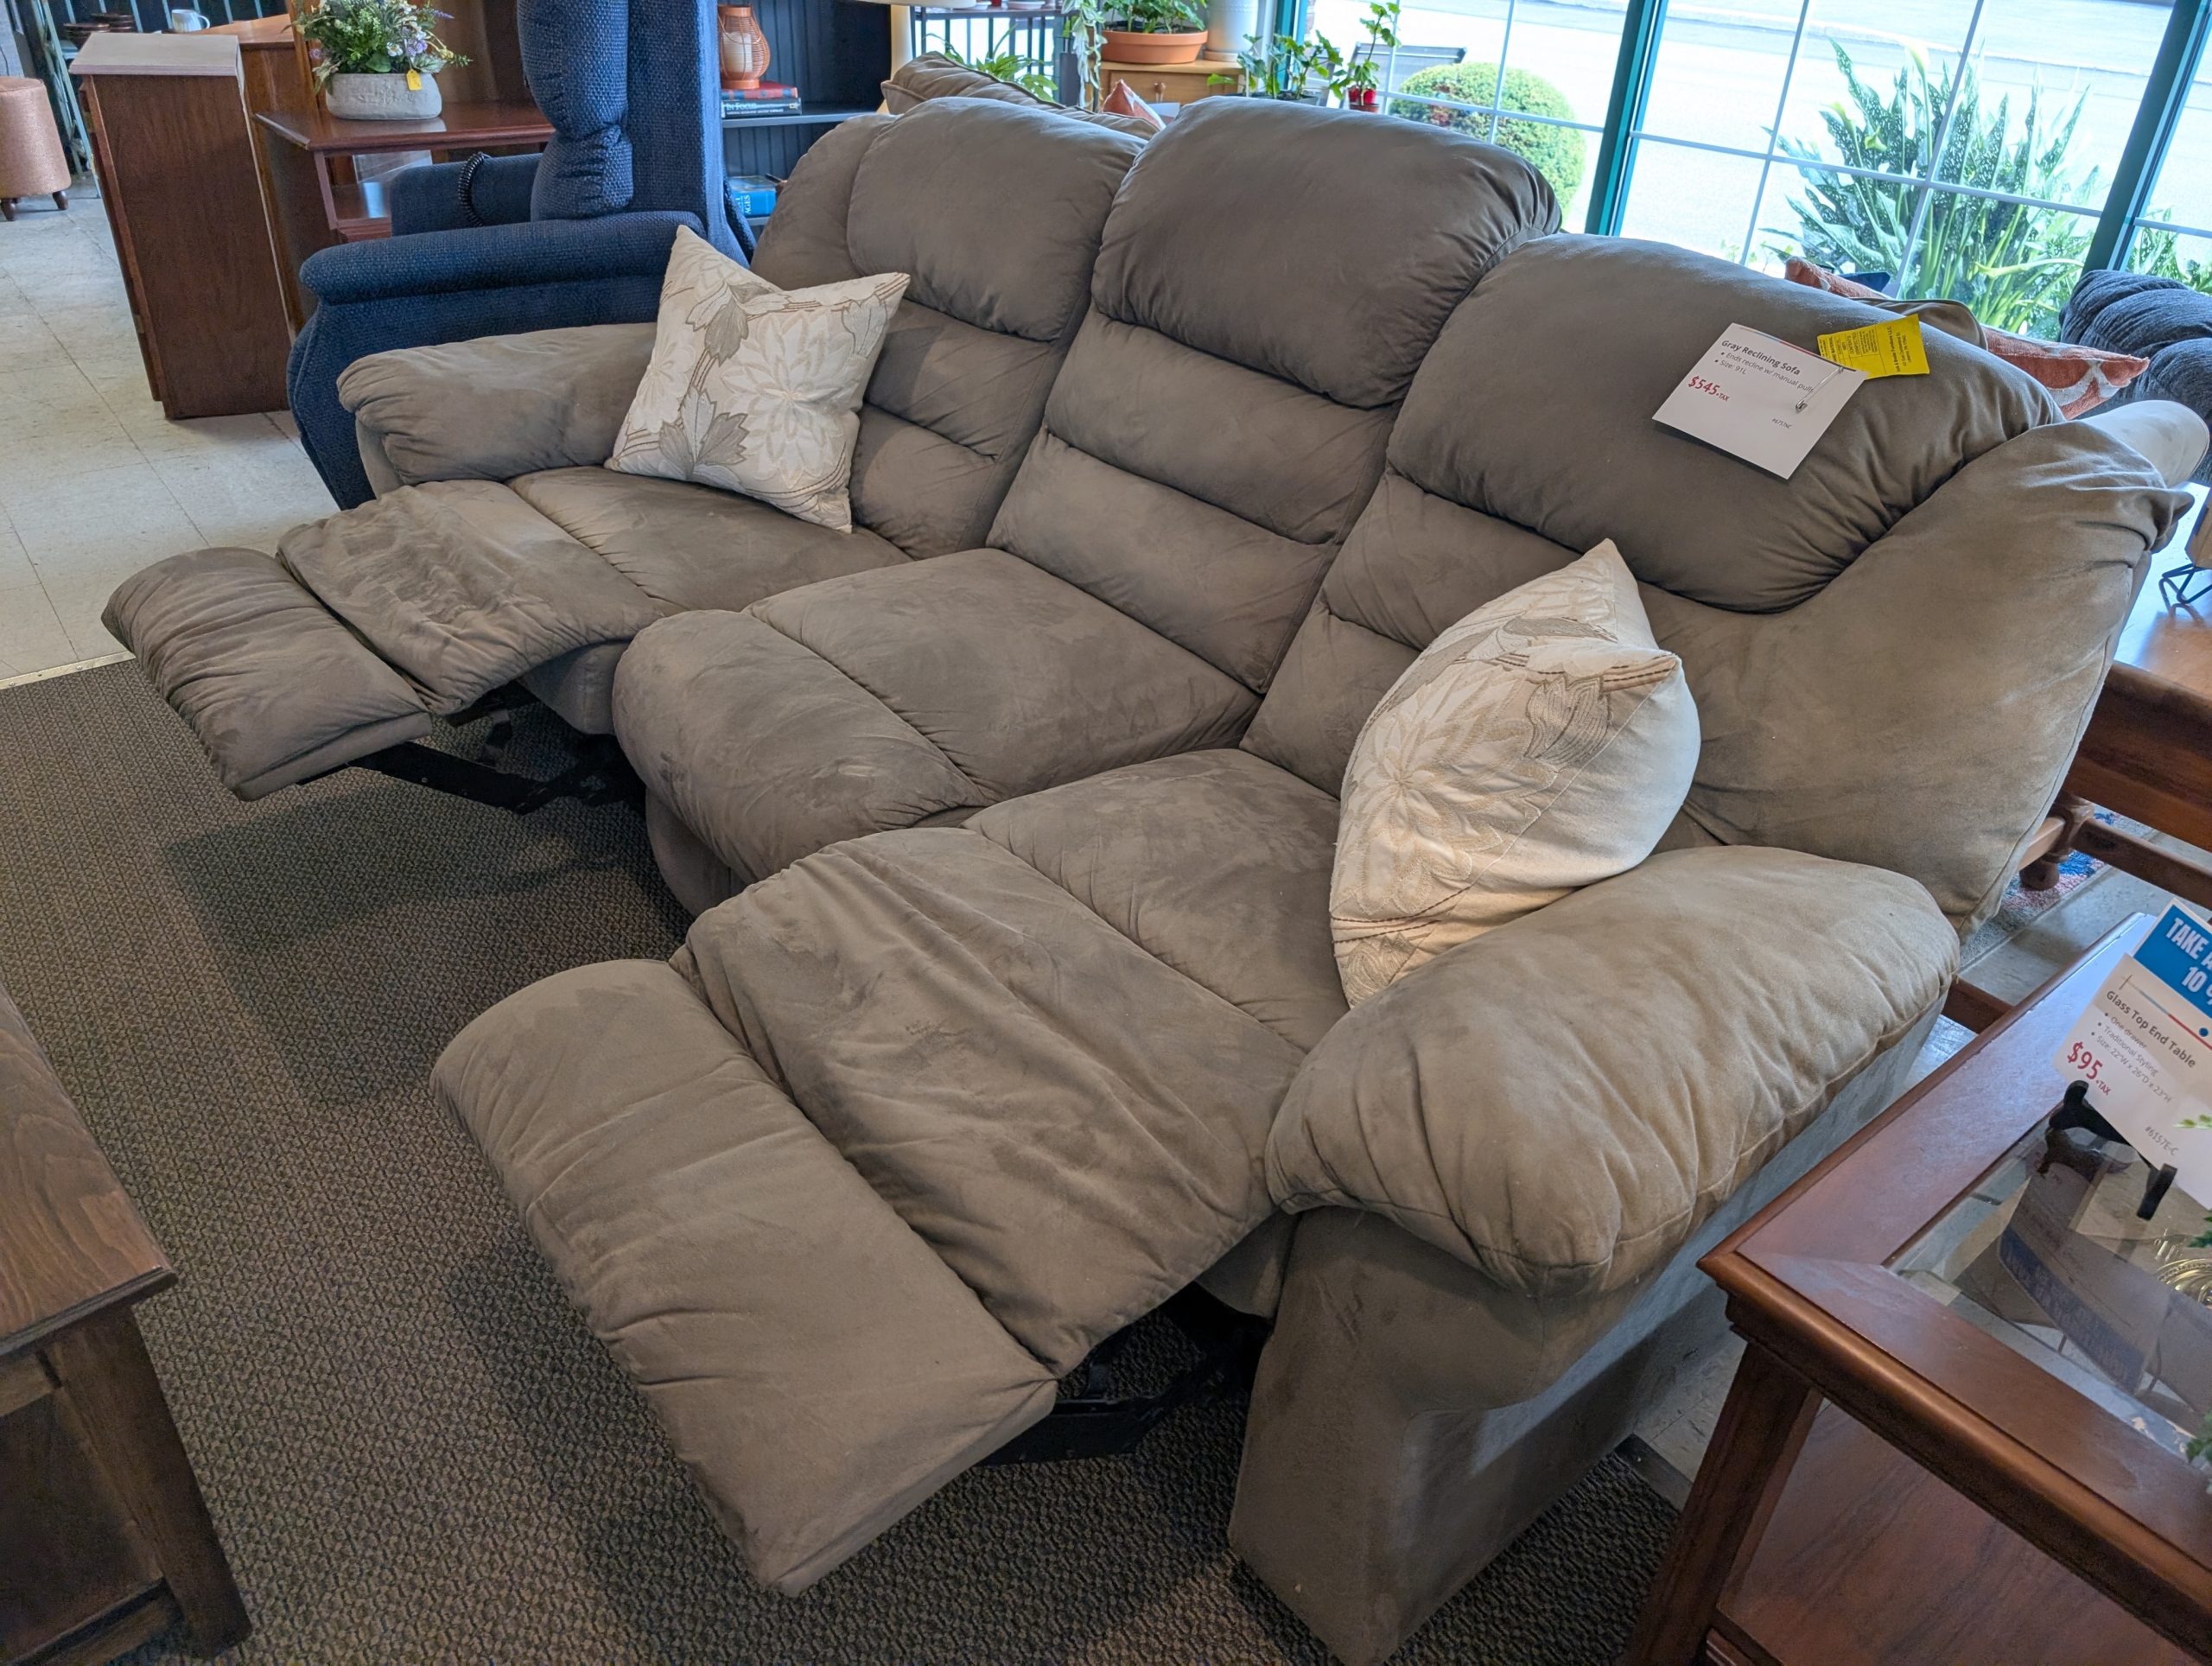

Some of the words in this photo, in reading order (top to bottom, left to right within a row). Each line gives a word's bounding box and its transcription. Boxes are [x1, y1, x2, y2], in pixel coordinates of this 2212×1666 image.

[1719, 359, 1735, 369] Size:
[1721, 340, 1741, 352] Gray
[1742, 347, 1781, 368] Reclining
[1780, 363, 1801, 375] Sofa
[1726, 353, 1741, 362] Ends
[1741, 359, 1764, 372] recline
[1773, 372, 1798, 386] manual
[2165, 917, 2209, 960] TAKE
[2181, 966, 2208, 993] 10
[2096, 1035, 2110, 1052] Size:
[2107, 990, 2131, 1014] Glass
[2131, 1010, 2149, 1029] Top
[2149, 1026, 2169, 1045] End
[2168, 1041, 2196, 1068] Table
[2110, 1016, 2124, 1030] One
[2124, 1027, 2148, 1049] drawer
[2067, 1041, 2103, 1080] $95
[2104, 1026, 2137, 1056] Traditional
[2136, 1054, 2158, 1078] Styling
